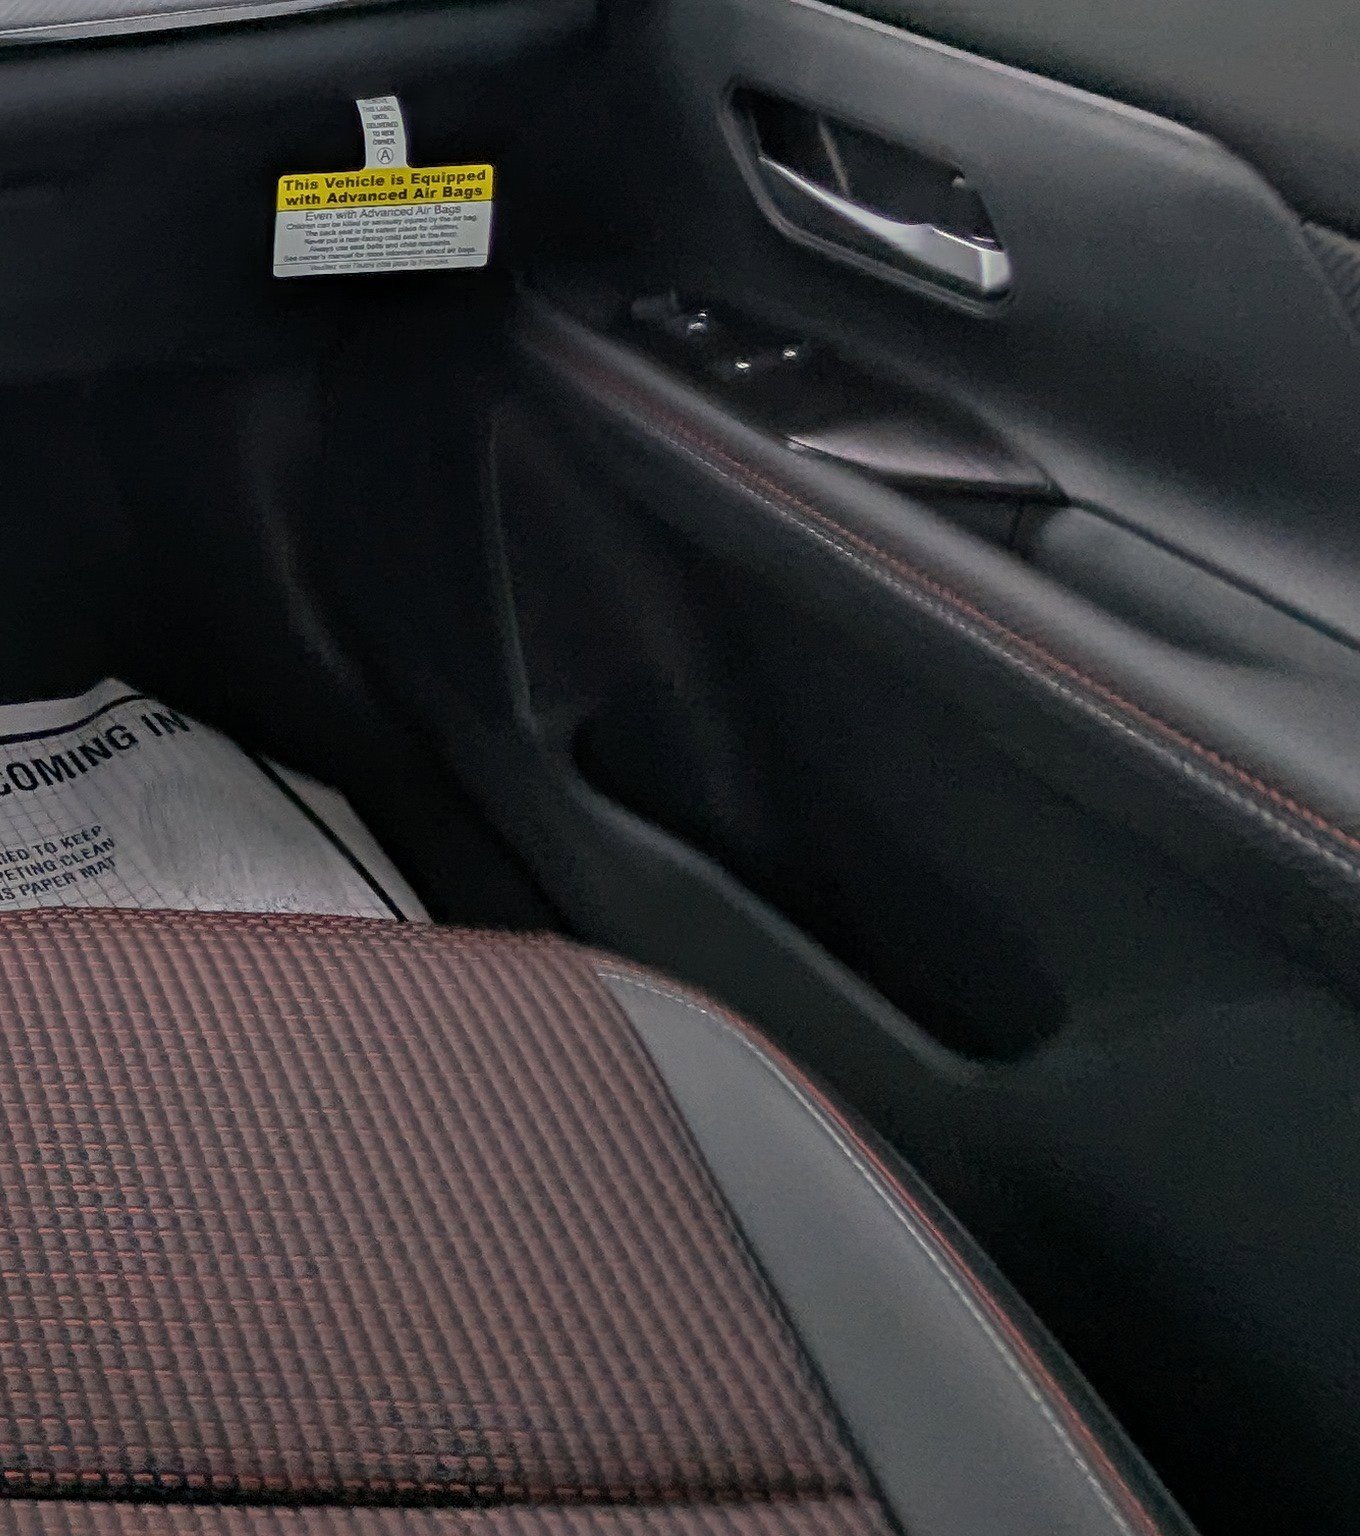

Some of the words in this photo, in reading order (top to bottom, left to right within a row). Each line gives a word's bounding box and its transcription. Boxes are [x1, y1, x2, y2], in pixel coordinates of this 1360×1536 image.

[283, 179, 319, 191] This
[324, 176, 385, 189] Vehicle
[391, 174, 404, 185] is
[410, 169, 486, 186] Equipped
[285, 193, 321, 206] with
[326, 189, 407, 204] Advanced
[413, 187, 436, 199] Air
[442, 185, 483, 200] Bags
[305, 212, 332, 221] Even
[336, 210, 357, 219] with
[359, 207, 413, 218] Advanced
[415, 206, 431, 215] Air
[434, 204, 461, 216] Bags
[139, 709, 190, 738] IN
[32, 840, 58, 856] TO
[60, 825, 102, 849] KEEP
[59, 837, 115, 866] CLEAN
[18, 872, 77, 897] PAPER
[79, 856, 117, 879] MAT
